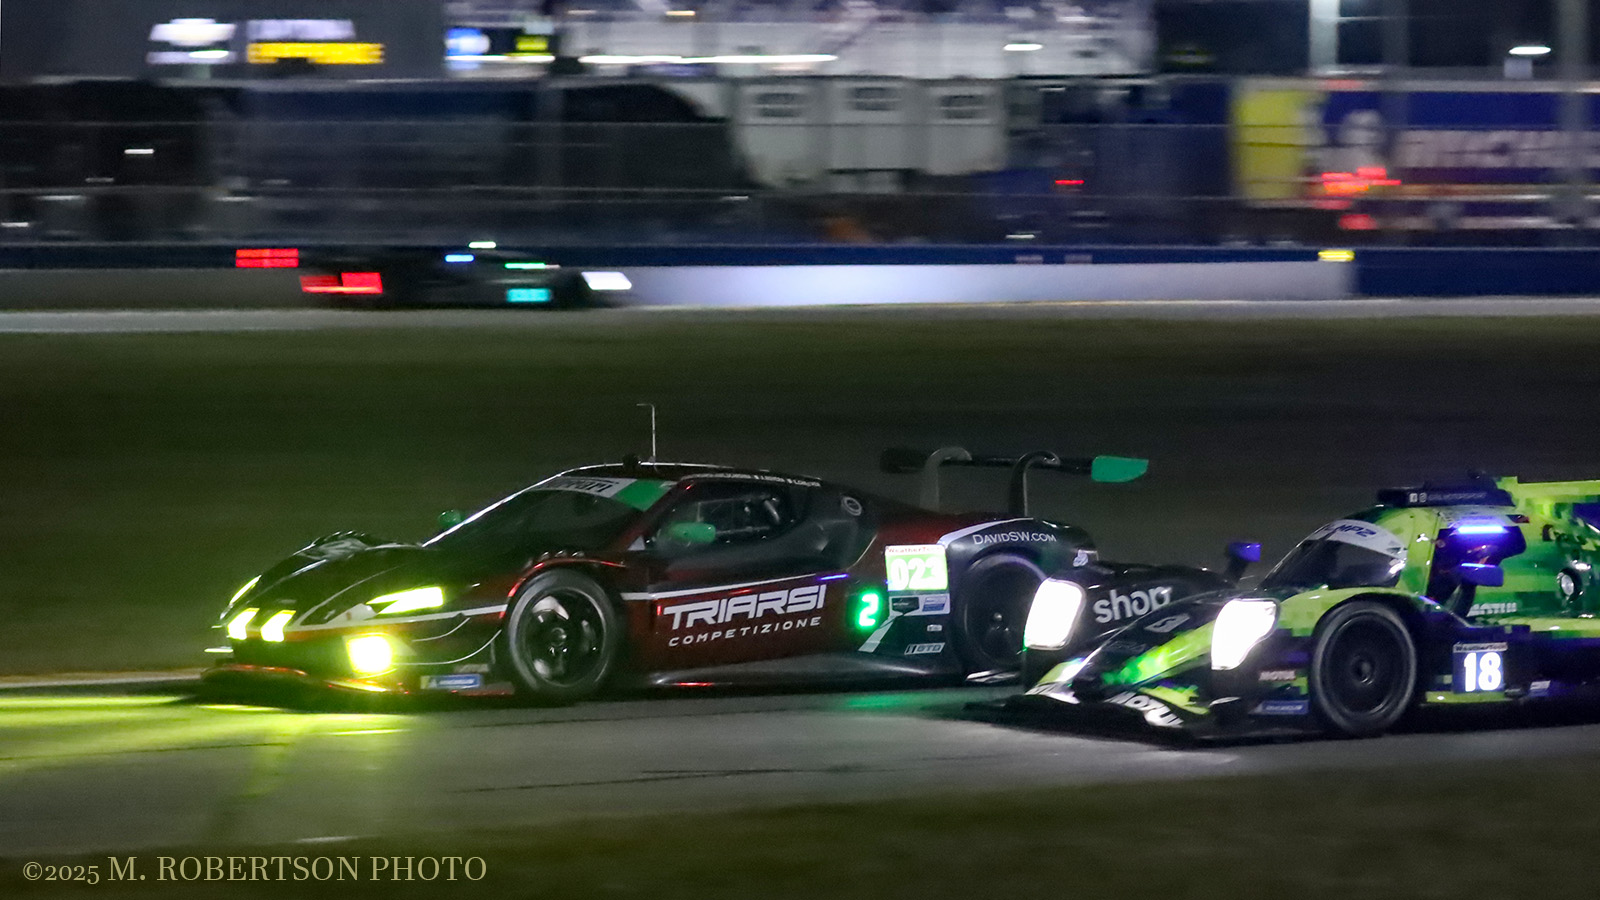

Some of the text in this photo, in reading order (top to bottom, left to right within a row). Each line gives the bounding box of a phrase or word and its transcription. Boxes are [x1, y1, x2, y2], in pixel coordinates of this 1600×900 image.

[890, 556, 946, 590] 023
[663, 584, 827, 630] TRIARSI
[858, 592, 879, 627] 2
[668, 616, 822, 647] COMPETIZIONE
[1463, 651, 1502, 692] 18
